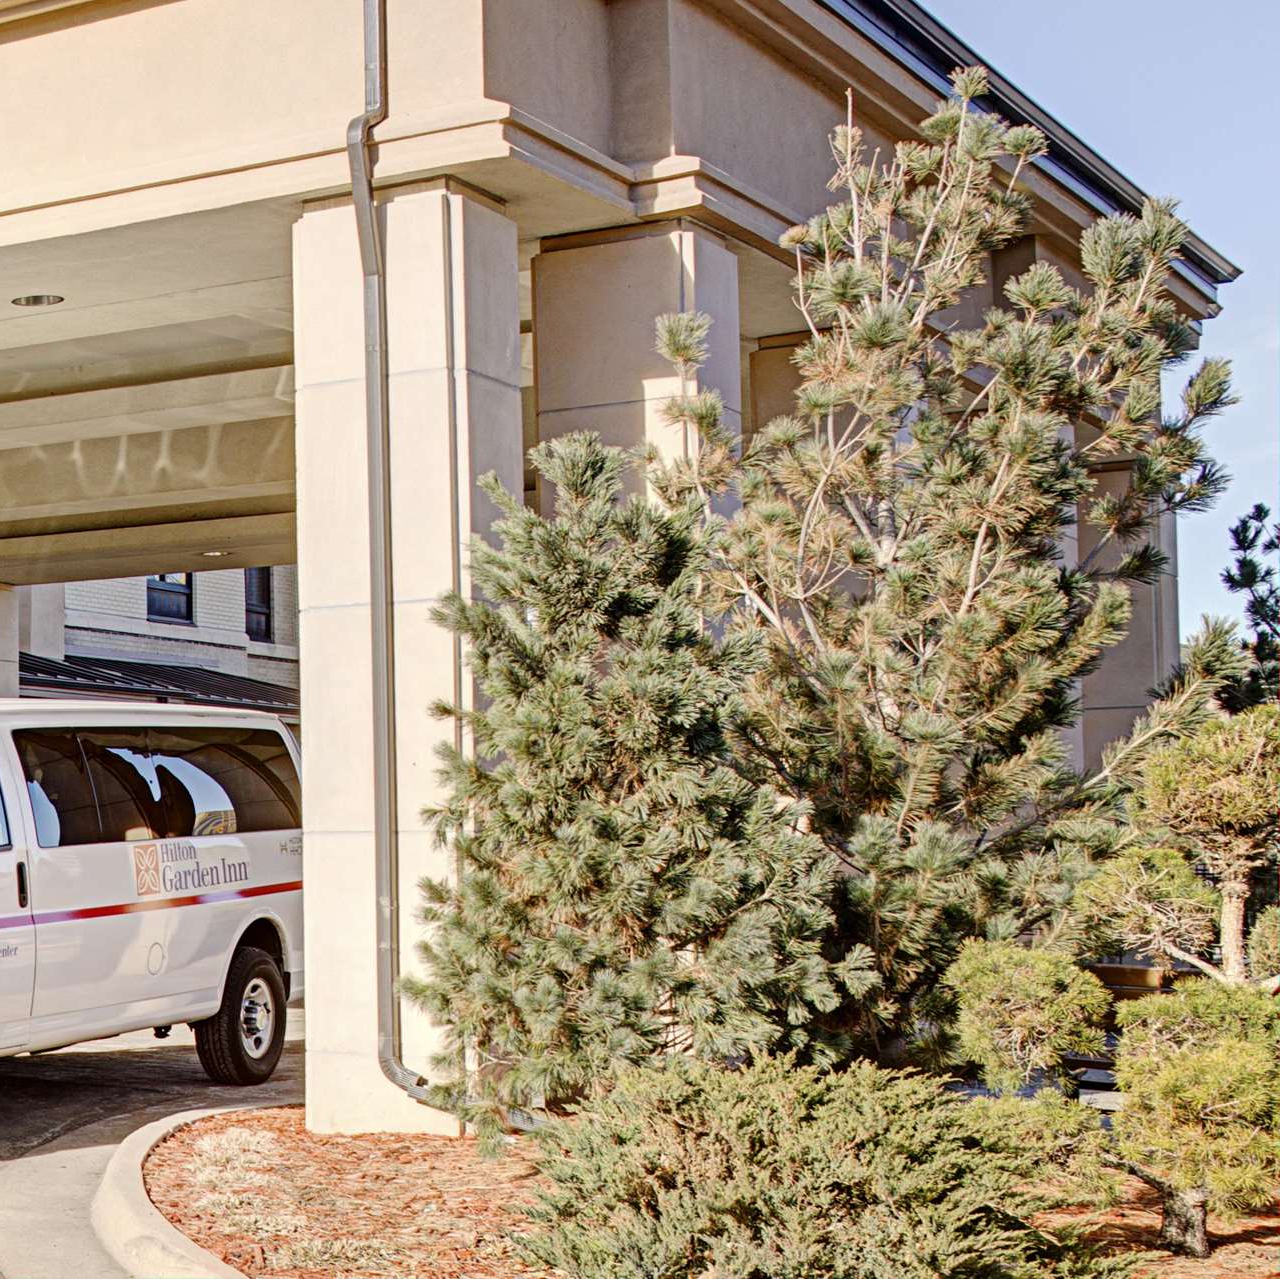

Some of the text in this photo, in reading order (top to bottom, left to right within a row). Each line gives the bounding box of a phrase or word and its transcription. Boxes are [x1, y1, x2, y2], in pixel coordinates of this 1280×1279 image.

[161, 843, 197, 863] Hilton
[162, 858, 248, 892] Garden Inn
